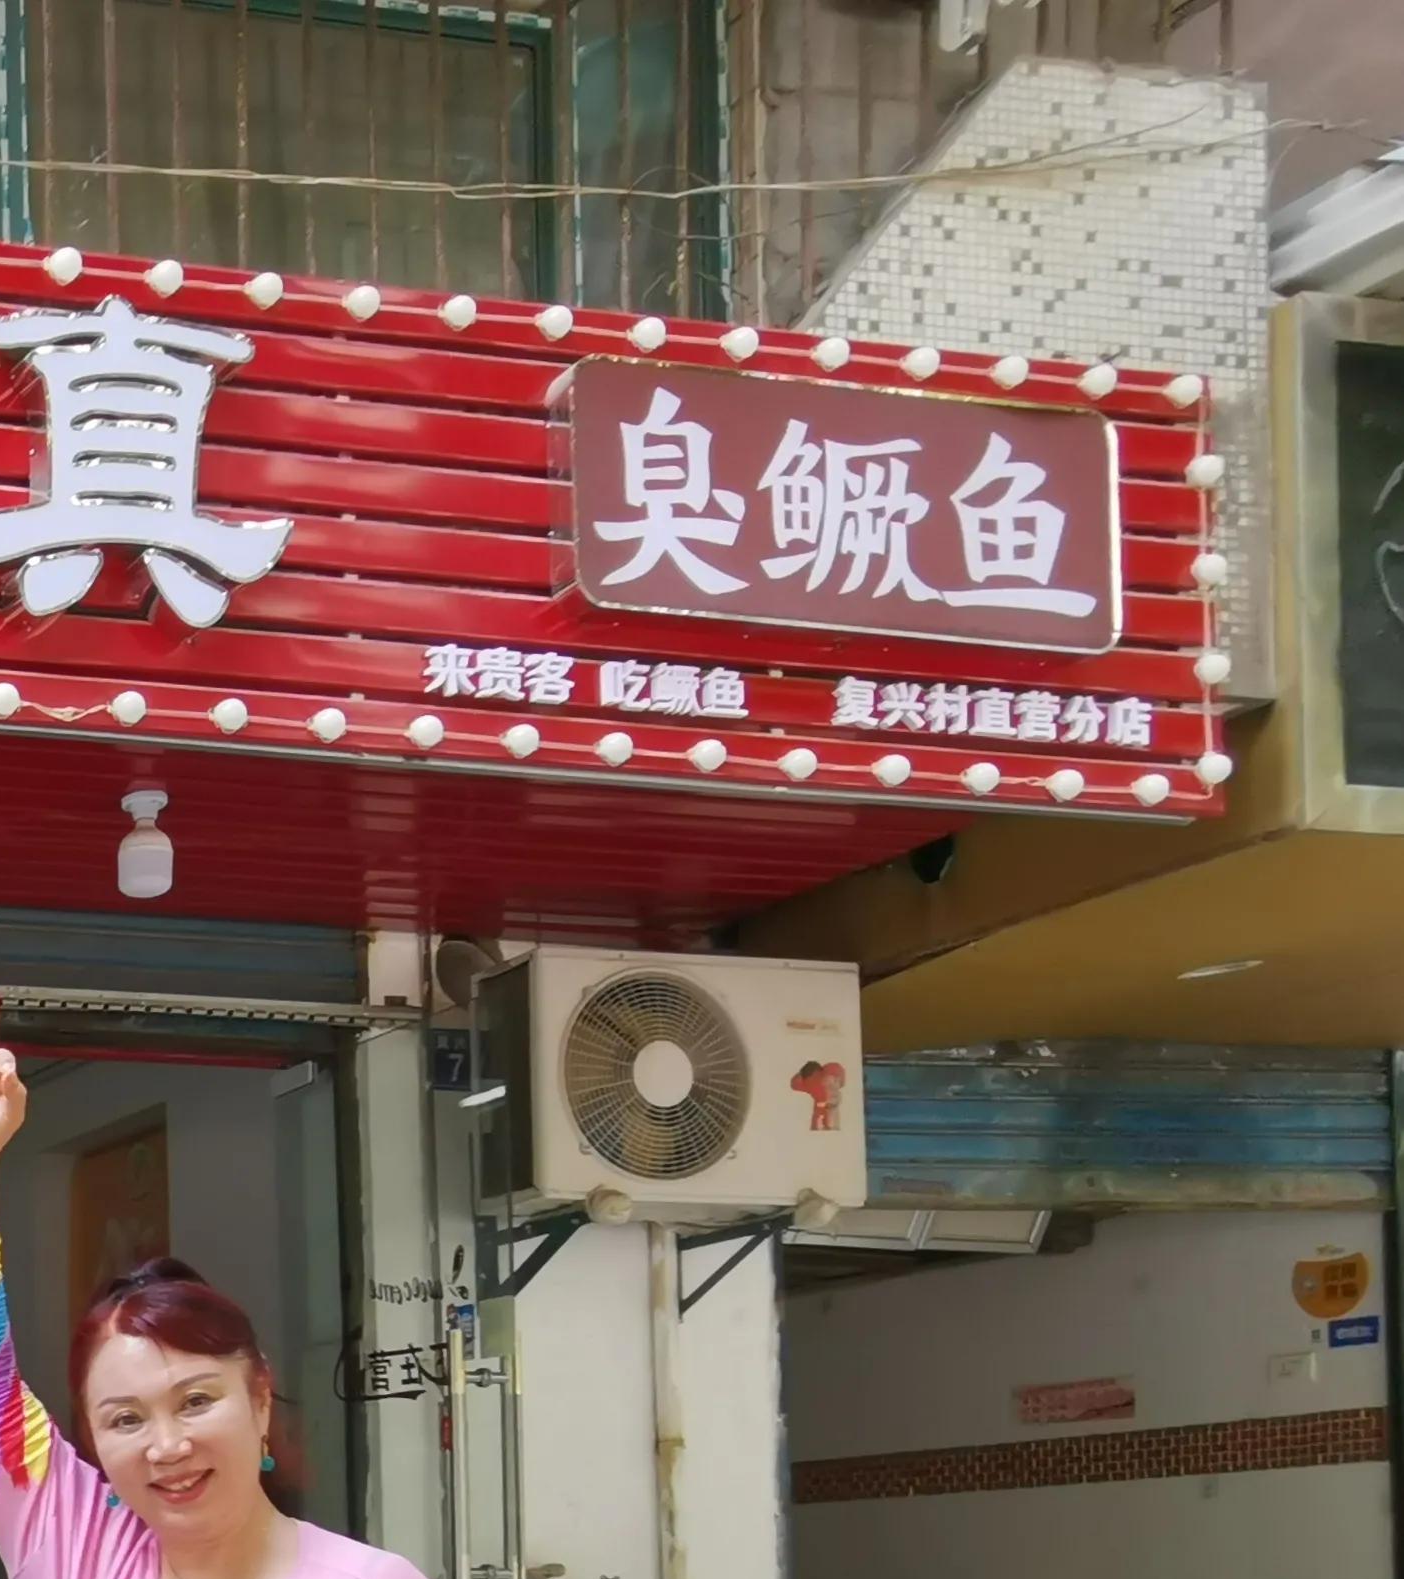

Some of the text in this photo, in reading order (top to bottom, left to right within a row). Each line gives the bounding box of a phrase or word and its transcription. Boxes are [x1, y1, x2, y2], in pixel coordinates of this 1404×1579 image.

[593, 385, 1097, 618] 臭鳜鱼
[424, 643, 575, 705] 来贵客
[831, 675, 1153, 747] 复兴村直营分店
